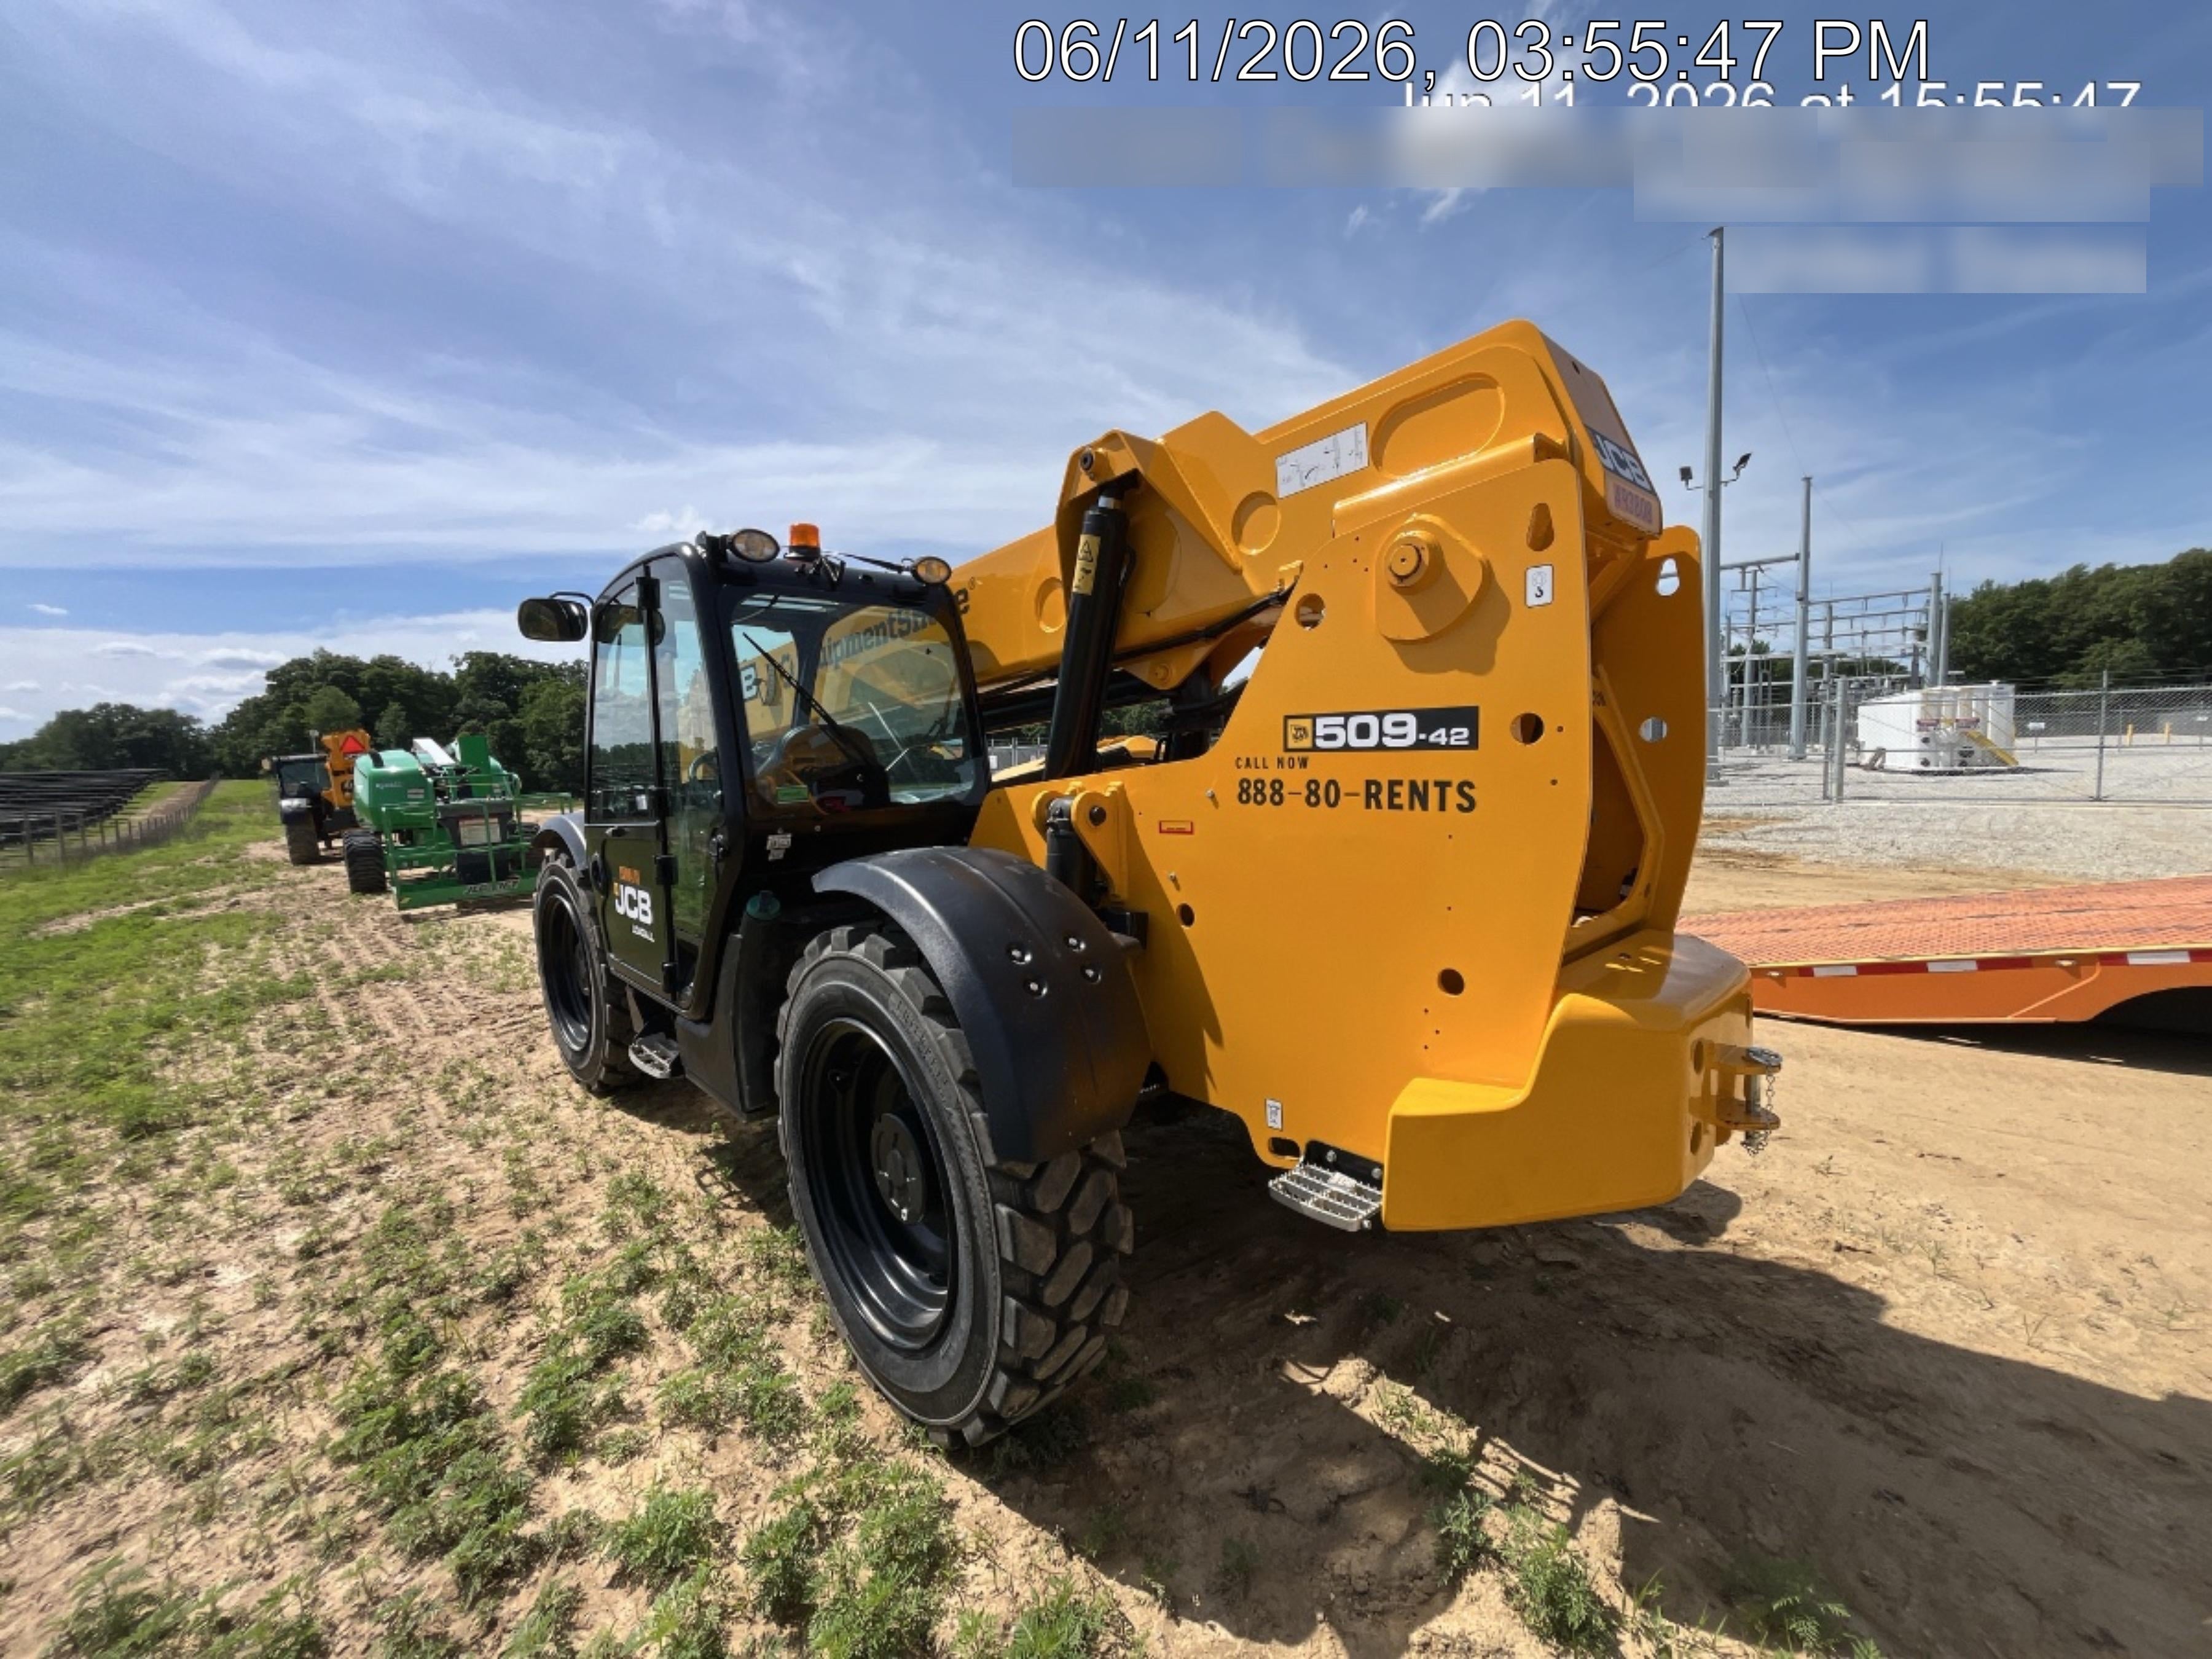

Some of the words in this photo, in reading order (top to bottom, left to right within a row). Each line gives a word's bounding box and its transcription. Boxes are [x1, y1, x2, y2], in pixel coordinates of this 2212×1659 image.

[1315, 712, 1470, 749] 509-42
[1235, 756, 1269, 769] CALL
[1277, 756, 1309, 769] NOW
[1237, 777, 1477, 813] 888-80-RENTS
[615, 883, 653, 925] JCB
